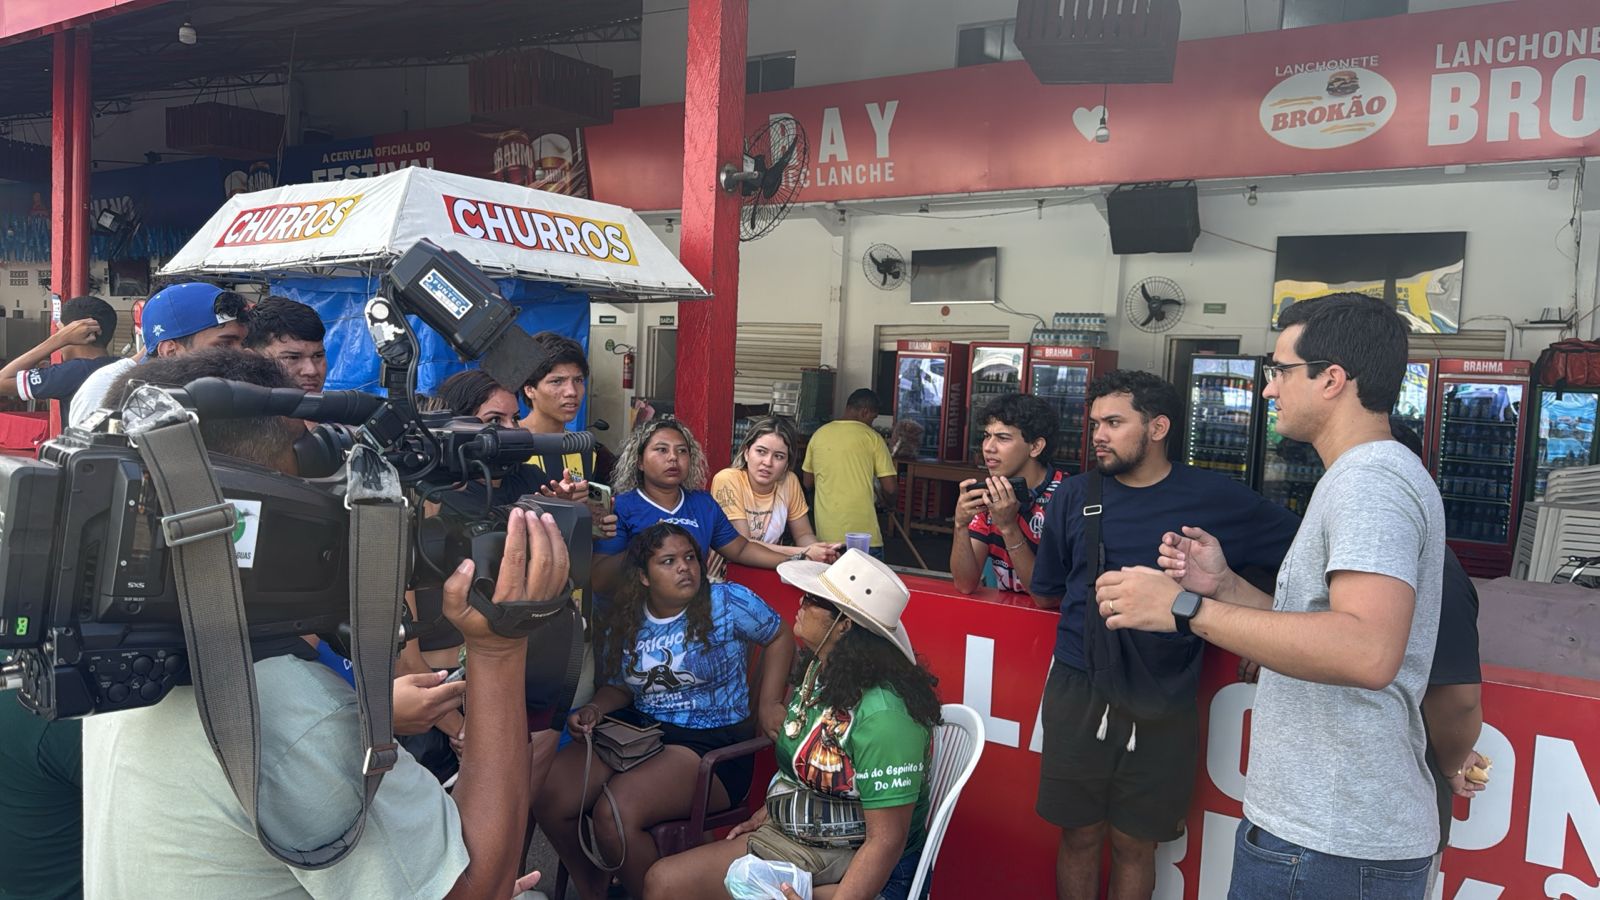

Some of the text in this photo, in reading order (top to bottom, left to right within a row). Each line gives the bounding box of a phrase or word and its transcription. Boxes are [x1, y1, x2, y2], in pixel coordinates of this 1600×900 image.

[1275, 55, 1379, 77] LANCHONETE
[1271, 94, 1387, 132] BROKÃO
[1428, 58, 1600, 146] BRO
[322, 141, 431, 163] A CERVEJA OFICIAL DO
[816, 162, 895, 187] LANCHE
[224, 199, 356, 244] CHURROS
[453, 198, 632, 262] CHURROS
[1045, 348, 1073, 358] BRAHMA
[1463, 361, 1504, 373] BRAHMA
[871, 768, 884, 778] do
[874, 781, 889, 791] Do
